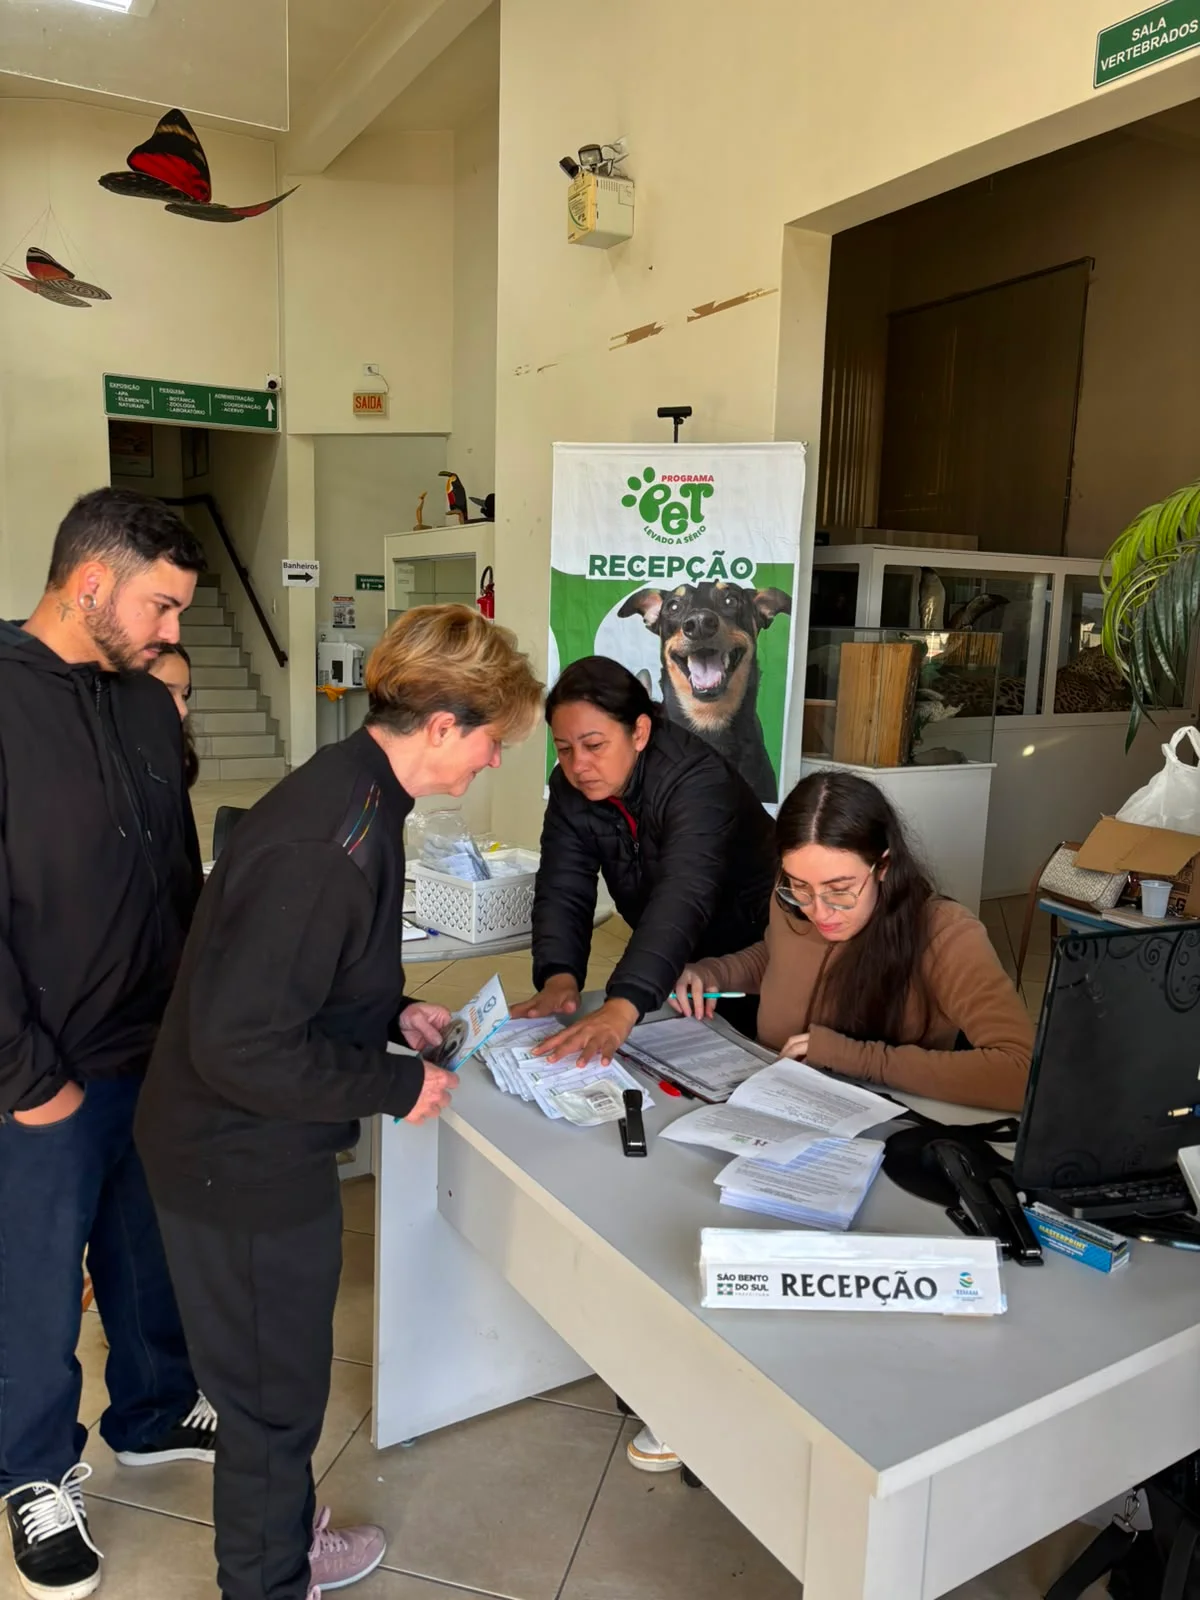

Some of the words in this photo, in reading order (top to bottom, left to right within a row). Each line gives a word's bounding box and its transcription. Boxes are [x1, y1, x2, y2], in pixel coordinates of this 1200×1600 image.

[1131, 16, 1167, 42] SALA
[1100, 19, 1199, 71] VERTEBRADOS
[661, 474, 715, 482] PROGRAMA
[643, 525, 675, 545] LEVADO
[675, 537, 683, 545] A
[683, 525, 707, 544] SÉRIO
[283, 562, 319, 570] Banheiros
[589, 550, 754, 582] RECEPÇÃO
[735, 1283, 749, 1291] DO
[751, 1283, 769, 1292] SUL
[738, 1273, 769, 1282] BENTO
[781, 1270, 938, 1305] RECEPÇÃO
